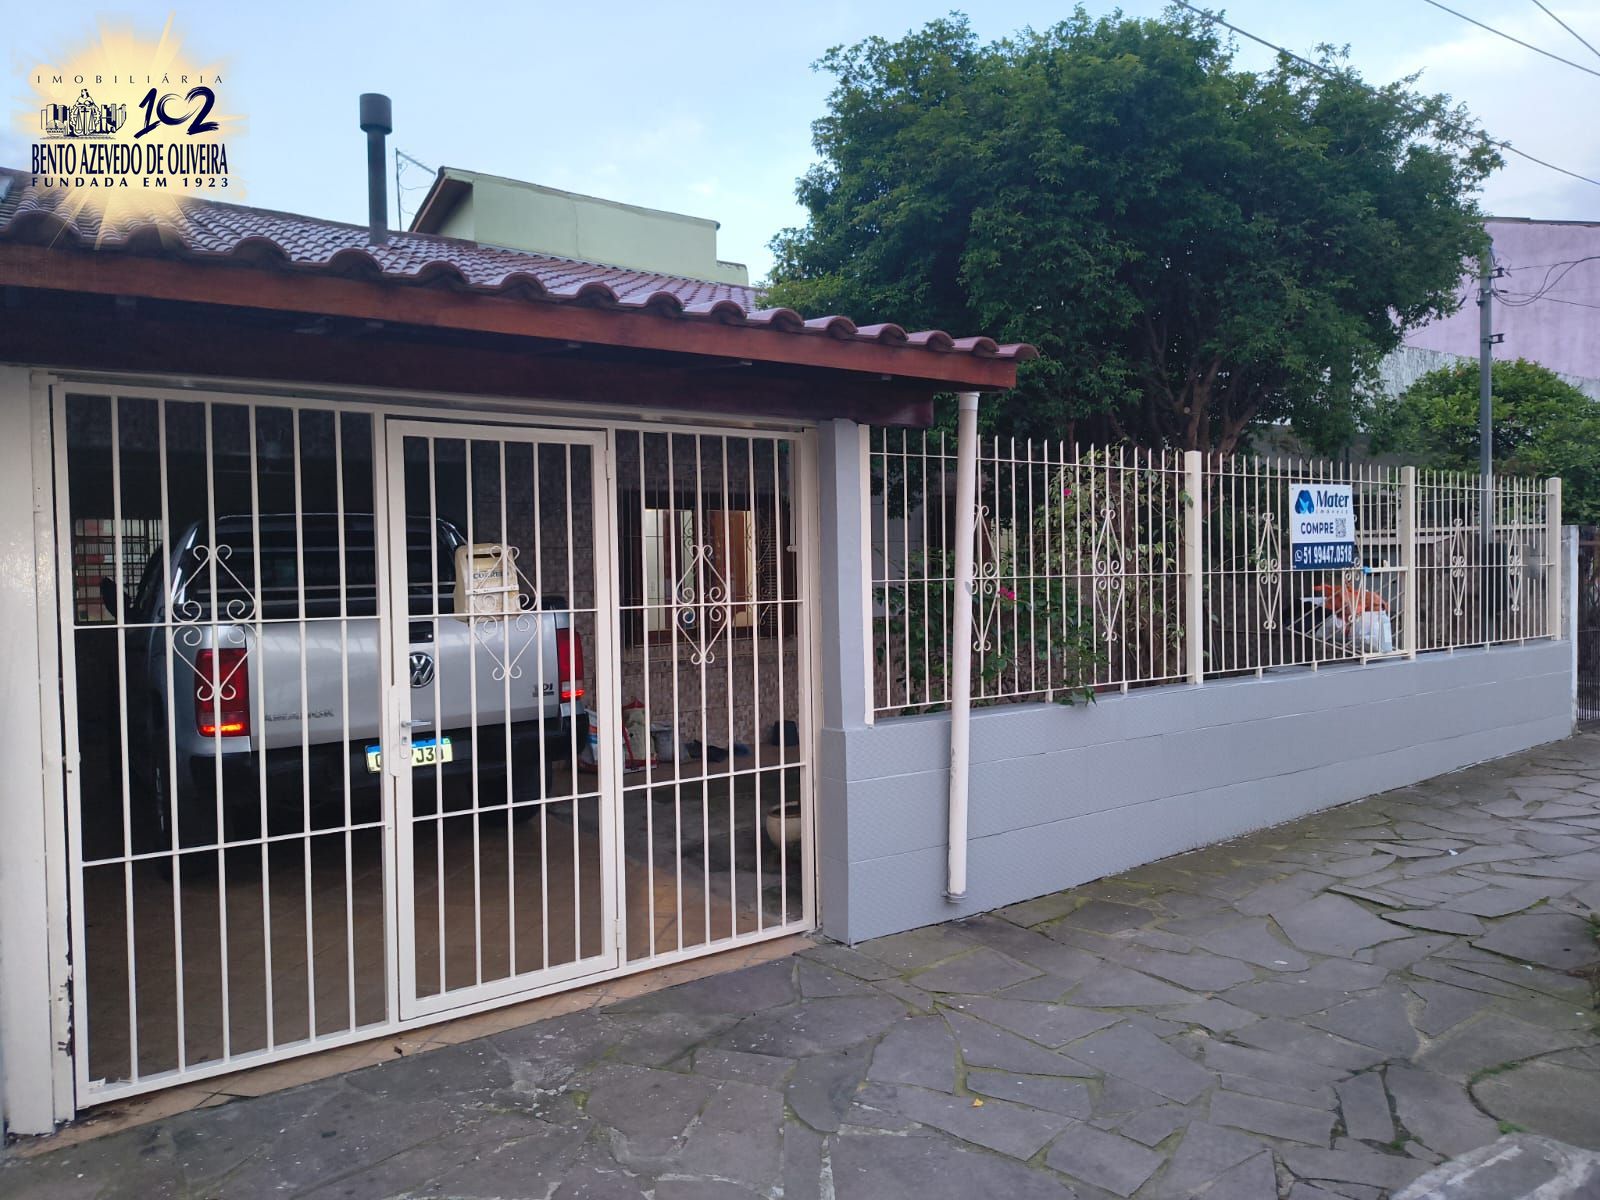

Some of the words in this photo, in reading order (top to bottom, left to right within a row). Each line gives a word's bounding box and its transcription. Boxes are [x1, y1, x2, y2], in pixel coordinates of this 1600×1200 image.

[1316, 490, 1350, 508] Mater
[1300, 521, 1334, 535] COMPRE
[1303, 546, 1312, 564] 51
[1313, 544, 1353, 564] 99447.0518
